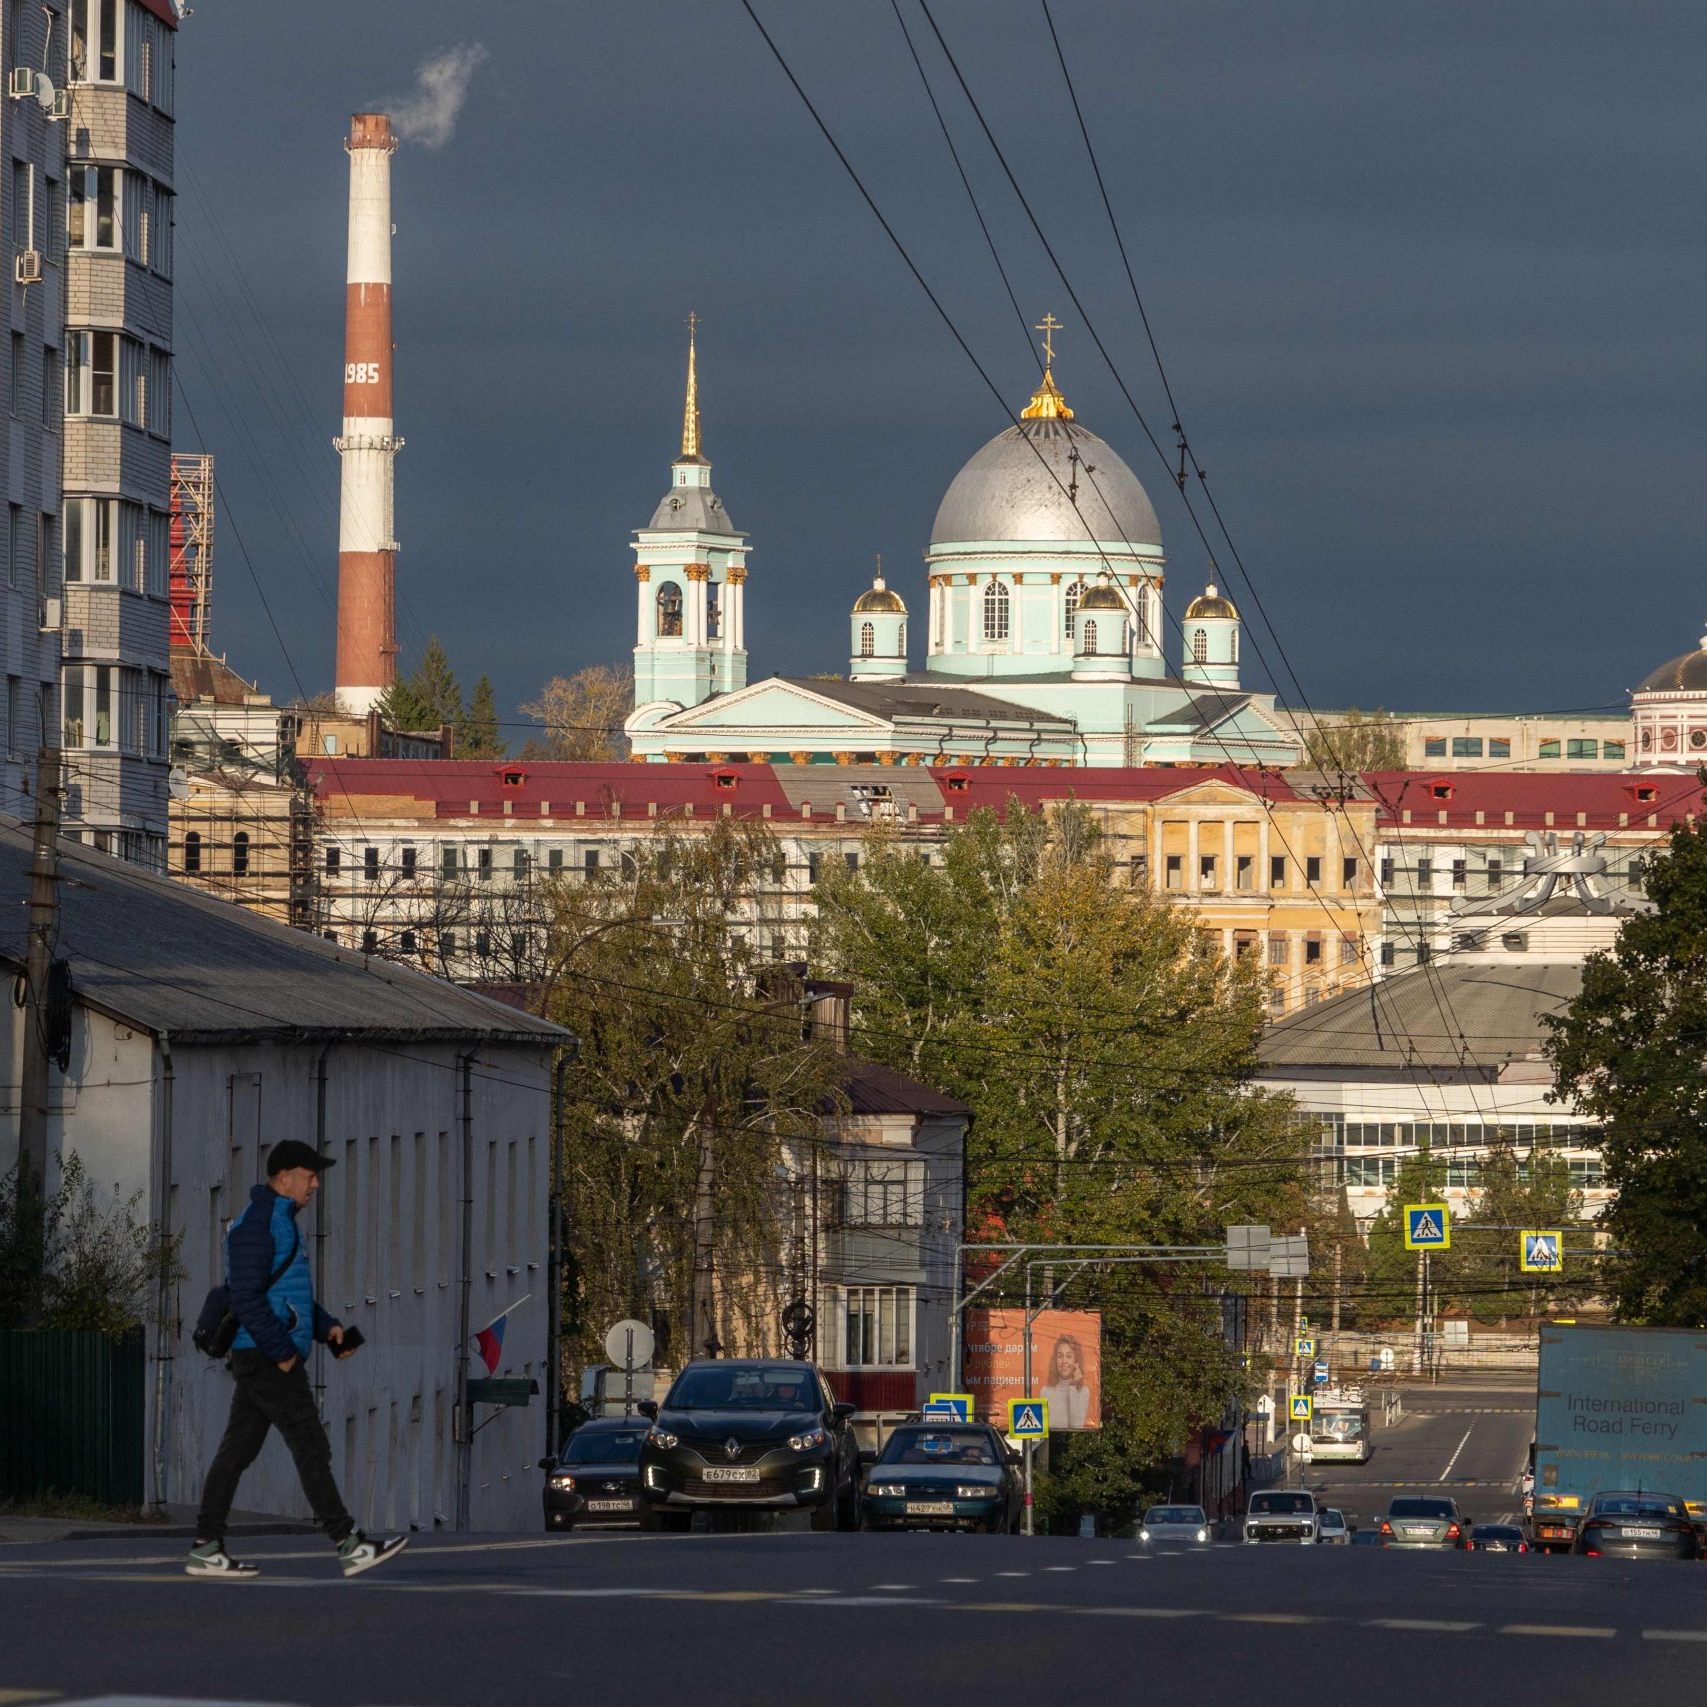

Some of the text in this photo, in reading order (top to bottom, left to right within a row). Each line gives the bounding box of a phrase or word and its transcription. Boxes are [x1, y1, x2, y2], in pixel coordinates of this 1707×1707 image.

[344, 362, 380, 384] 1985
[1004, 1343, 1038, 1355] дарм
[983, 1375, 1039, 1386] пациентм
[1568, 1393, 1686, 1415] International
[1573, 1415, 1679, 1440] Road Ferry
